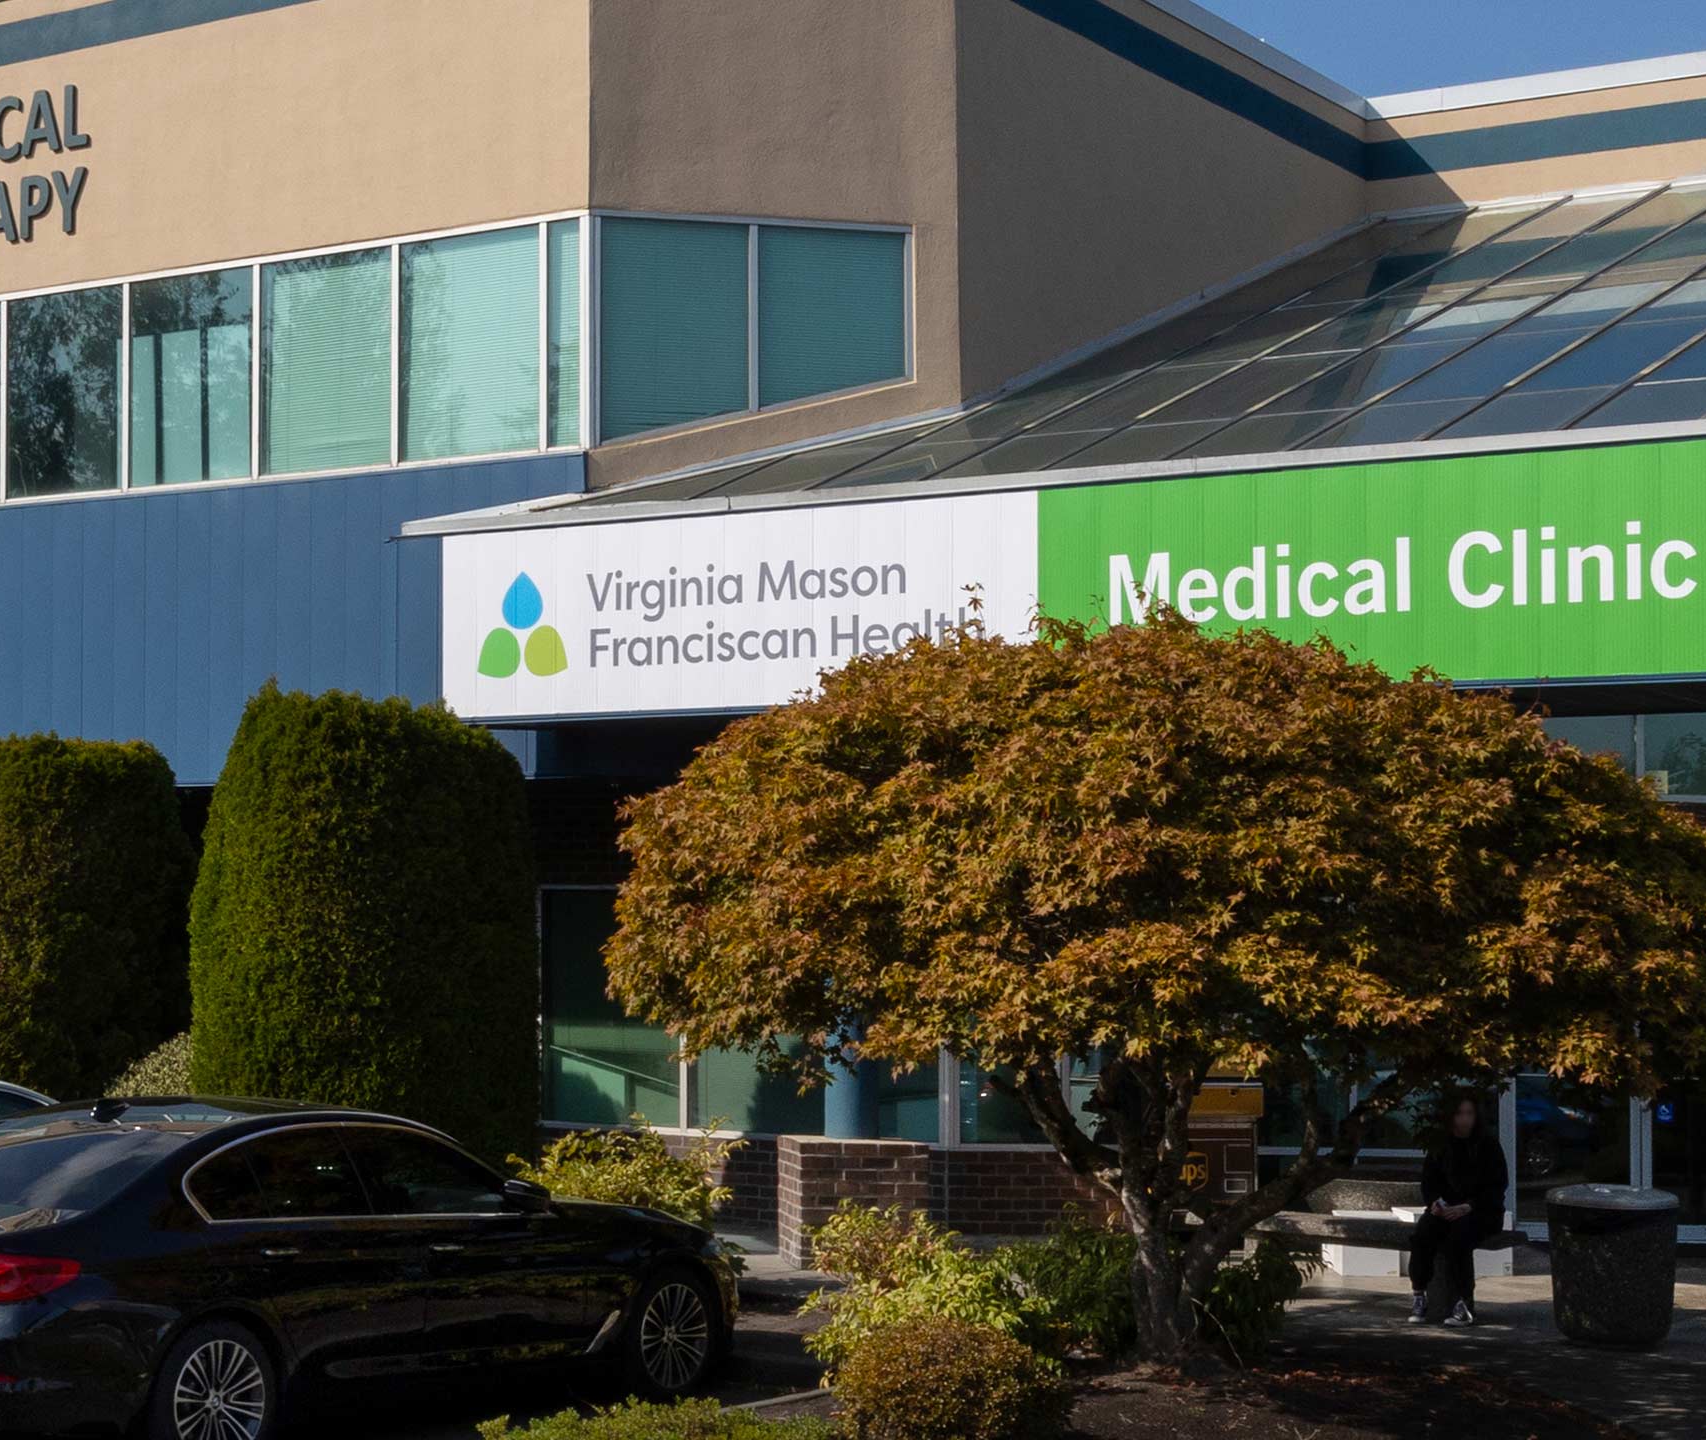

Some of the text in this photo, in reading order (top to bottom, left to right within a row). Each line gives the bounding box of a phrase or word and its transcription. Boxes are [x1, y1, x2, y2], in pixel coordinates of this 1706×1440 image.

[587, 560, 907, 622] Virginia Mason
[1108, 520, 1698, 627] Medical Clinic
[589, 620, 818, 667] Franciscan
